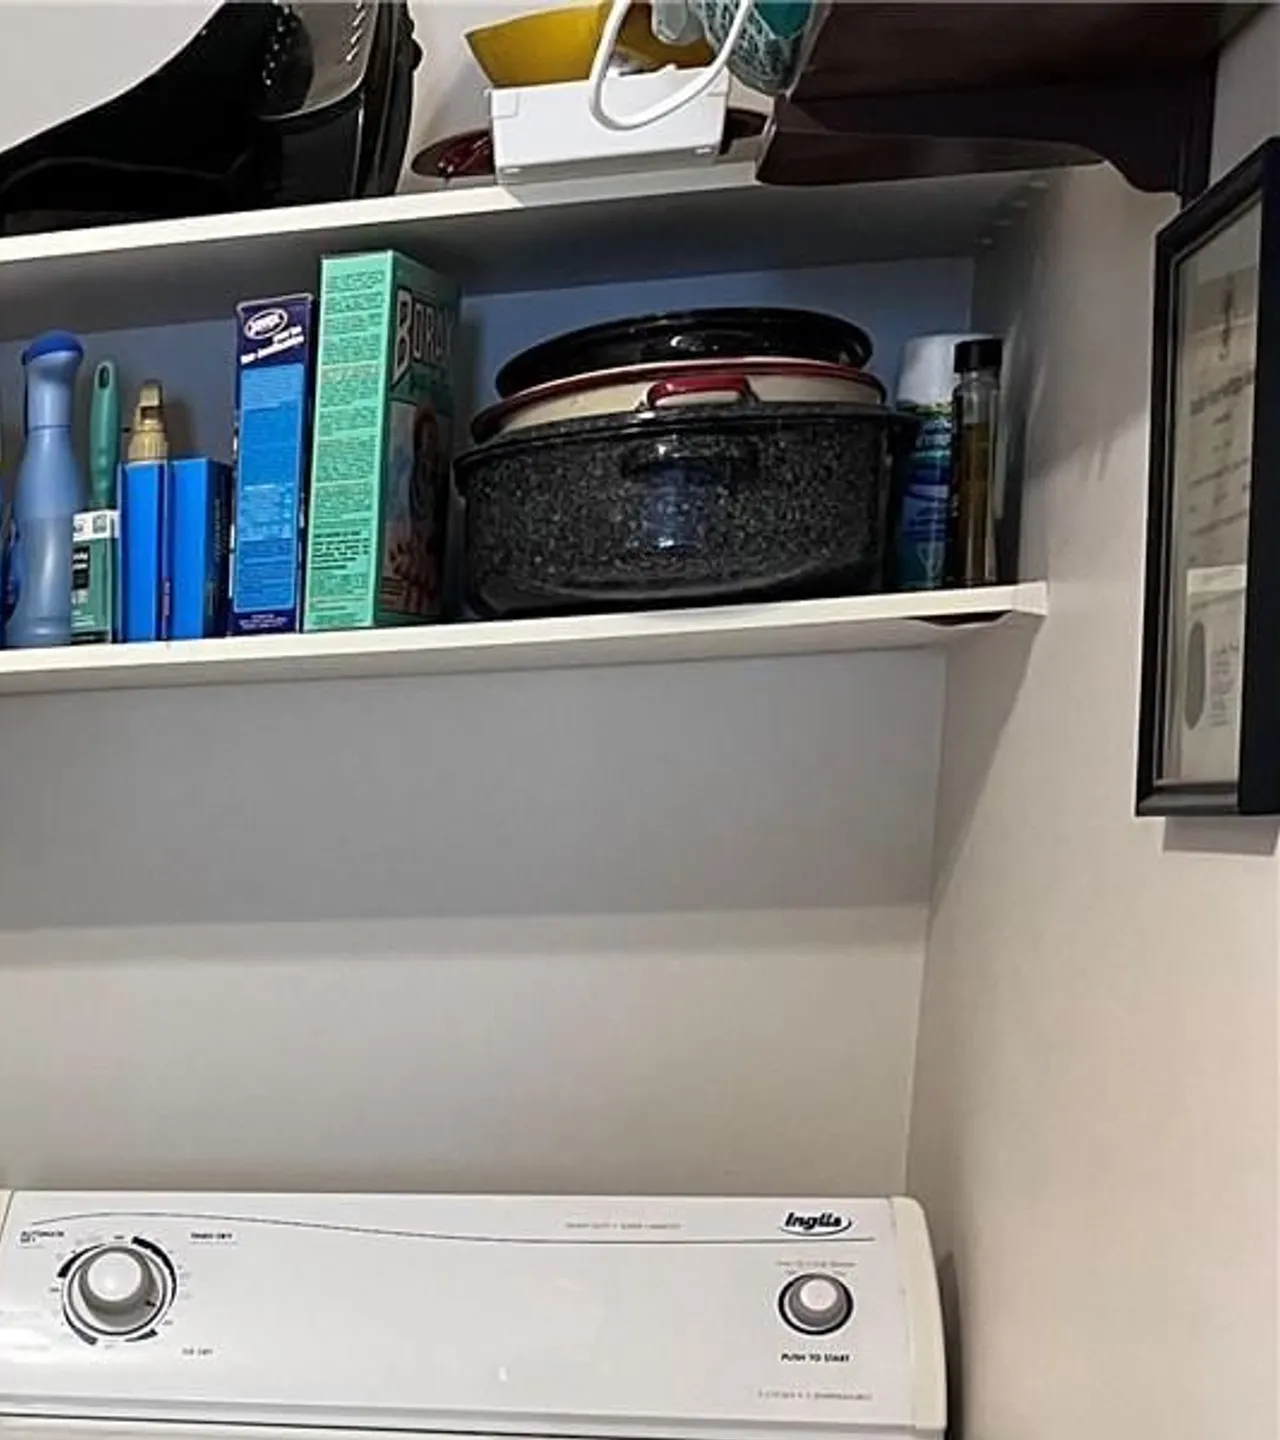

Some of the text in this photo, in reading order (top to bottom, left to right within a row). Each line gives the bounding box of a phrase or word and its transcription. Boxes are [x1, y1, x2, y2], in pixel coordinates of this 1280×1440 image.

[785, 1212, 843, 1231] Inglis
[781, 1353, 850, 1363] PUSH TO START
